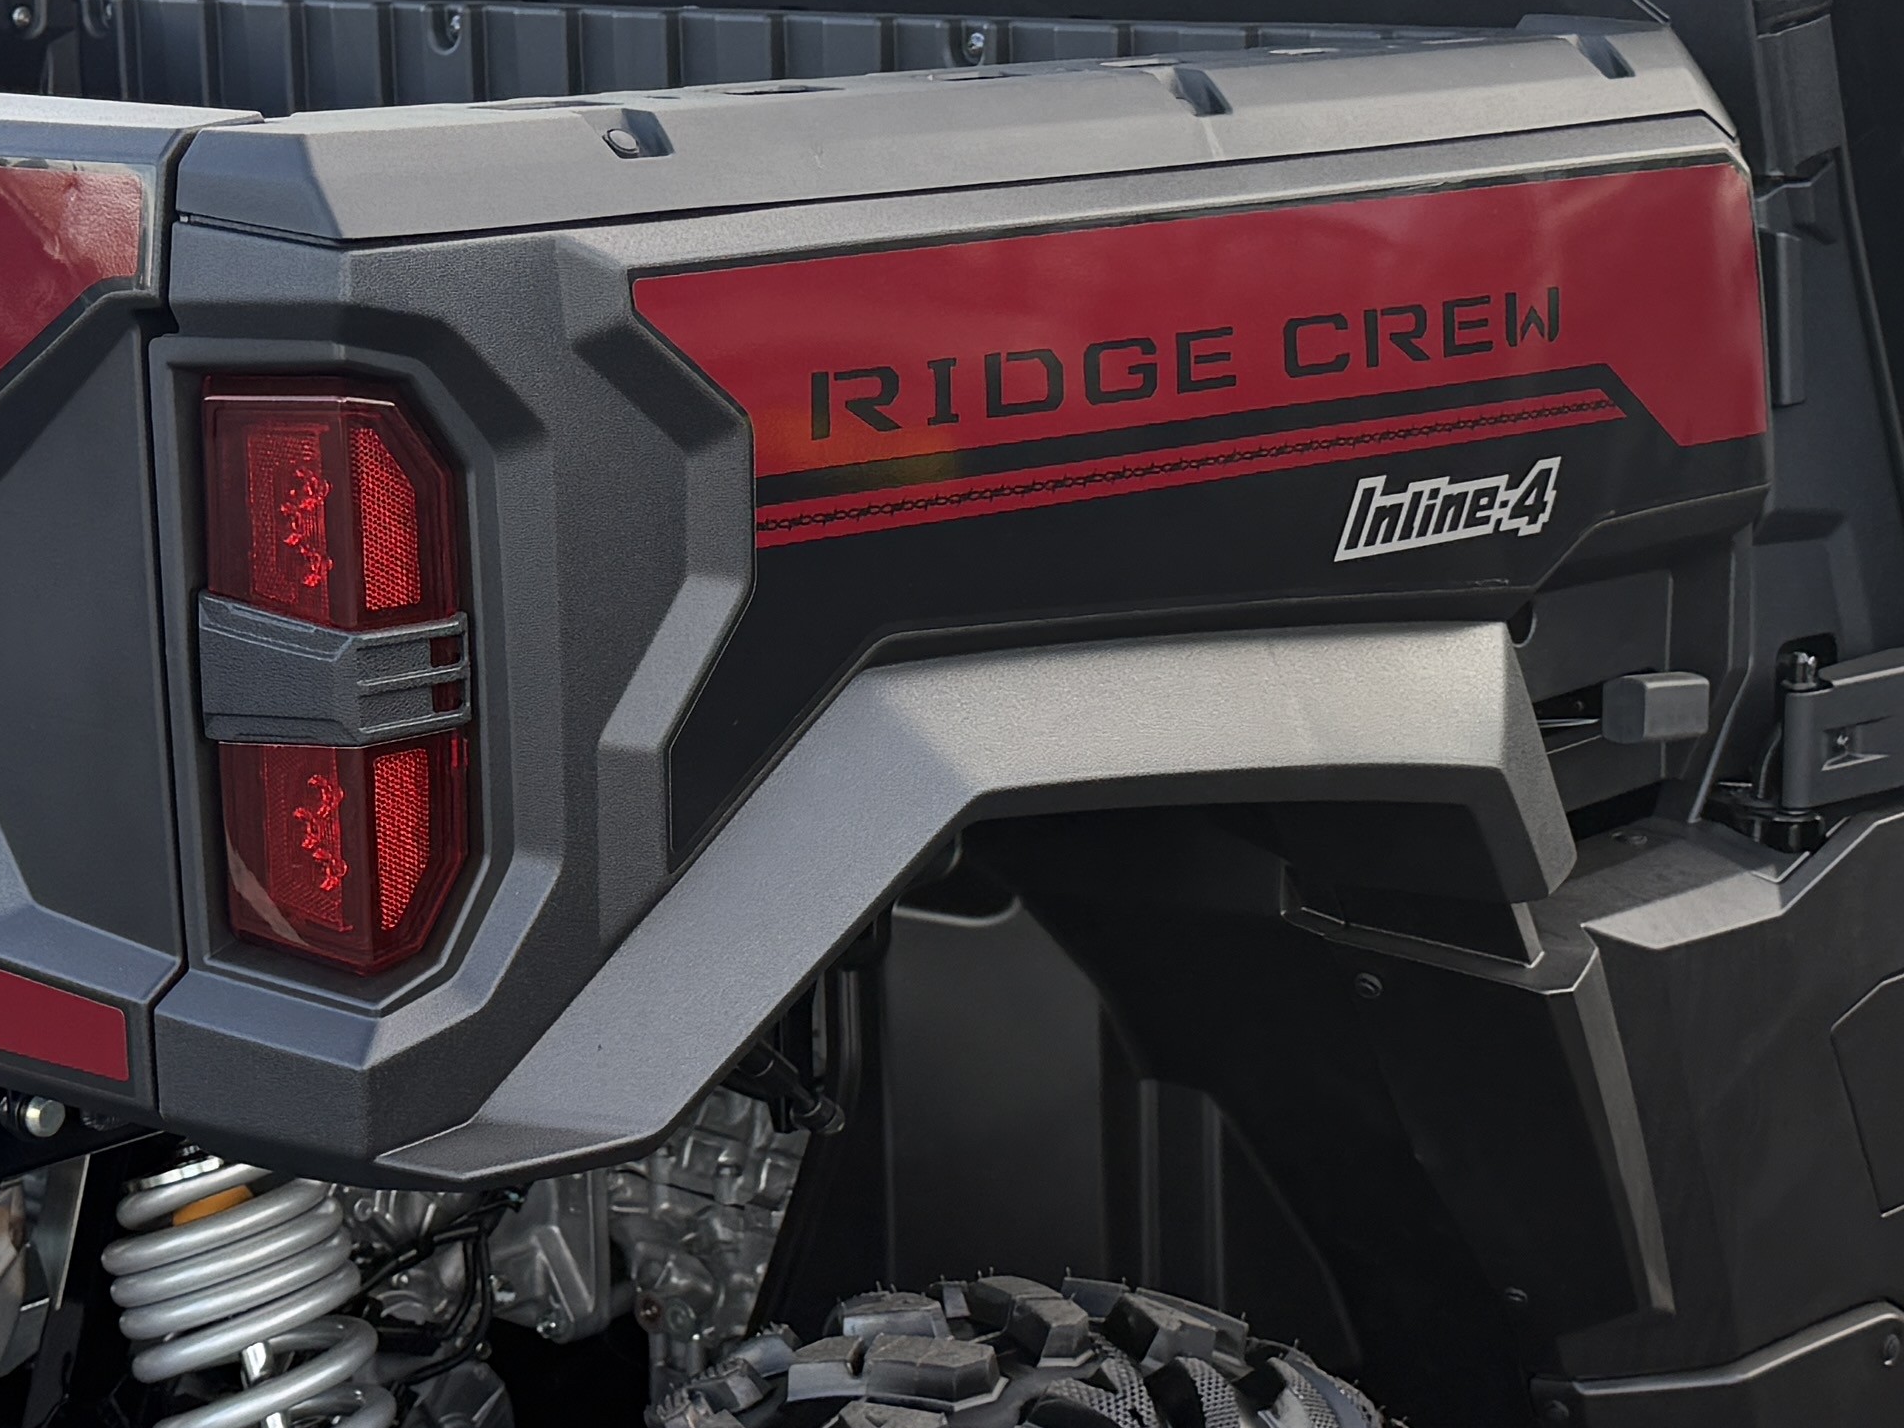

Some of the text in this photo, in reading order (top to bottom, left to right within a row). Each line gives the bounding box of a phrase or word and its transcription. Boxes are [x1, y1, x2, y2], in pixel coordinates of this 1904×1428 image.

[810, 287, 1560, 440] RIDGE CREW
[1334, 456, 1561, 562] Inline-4
